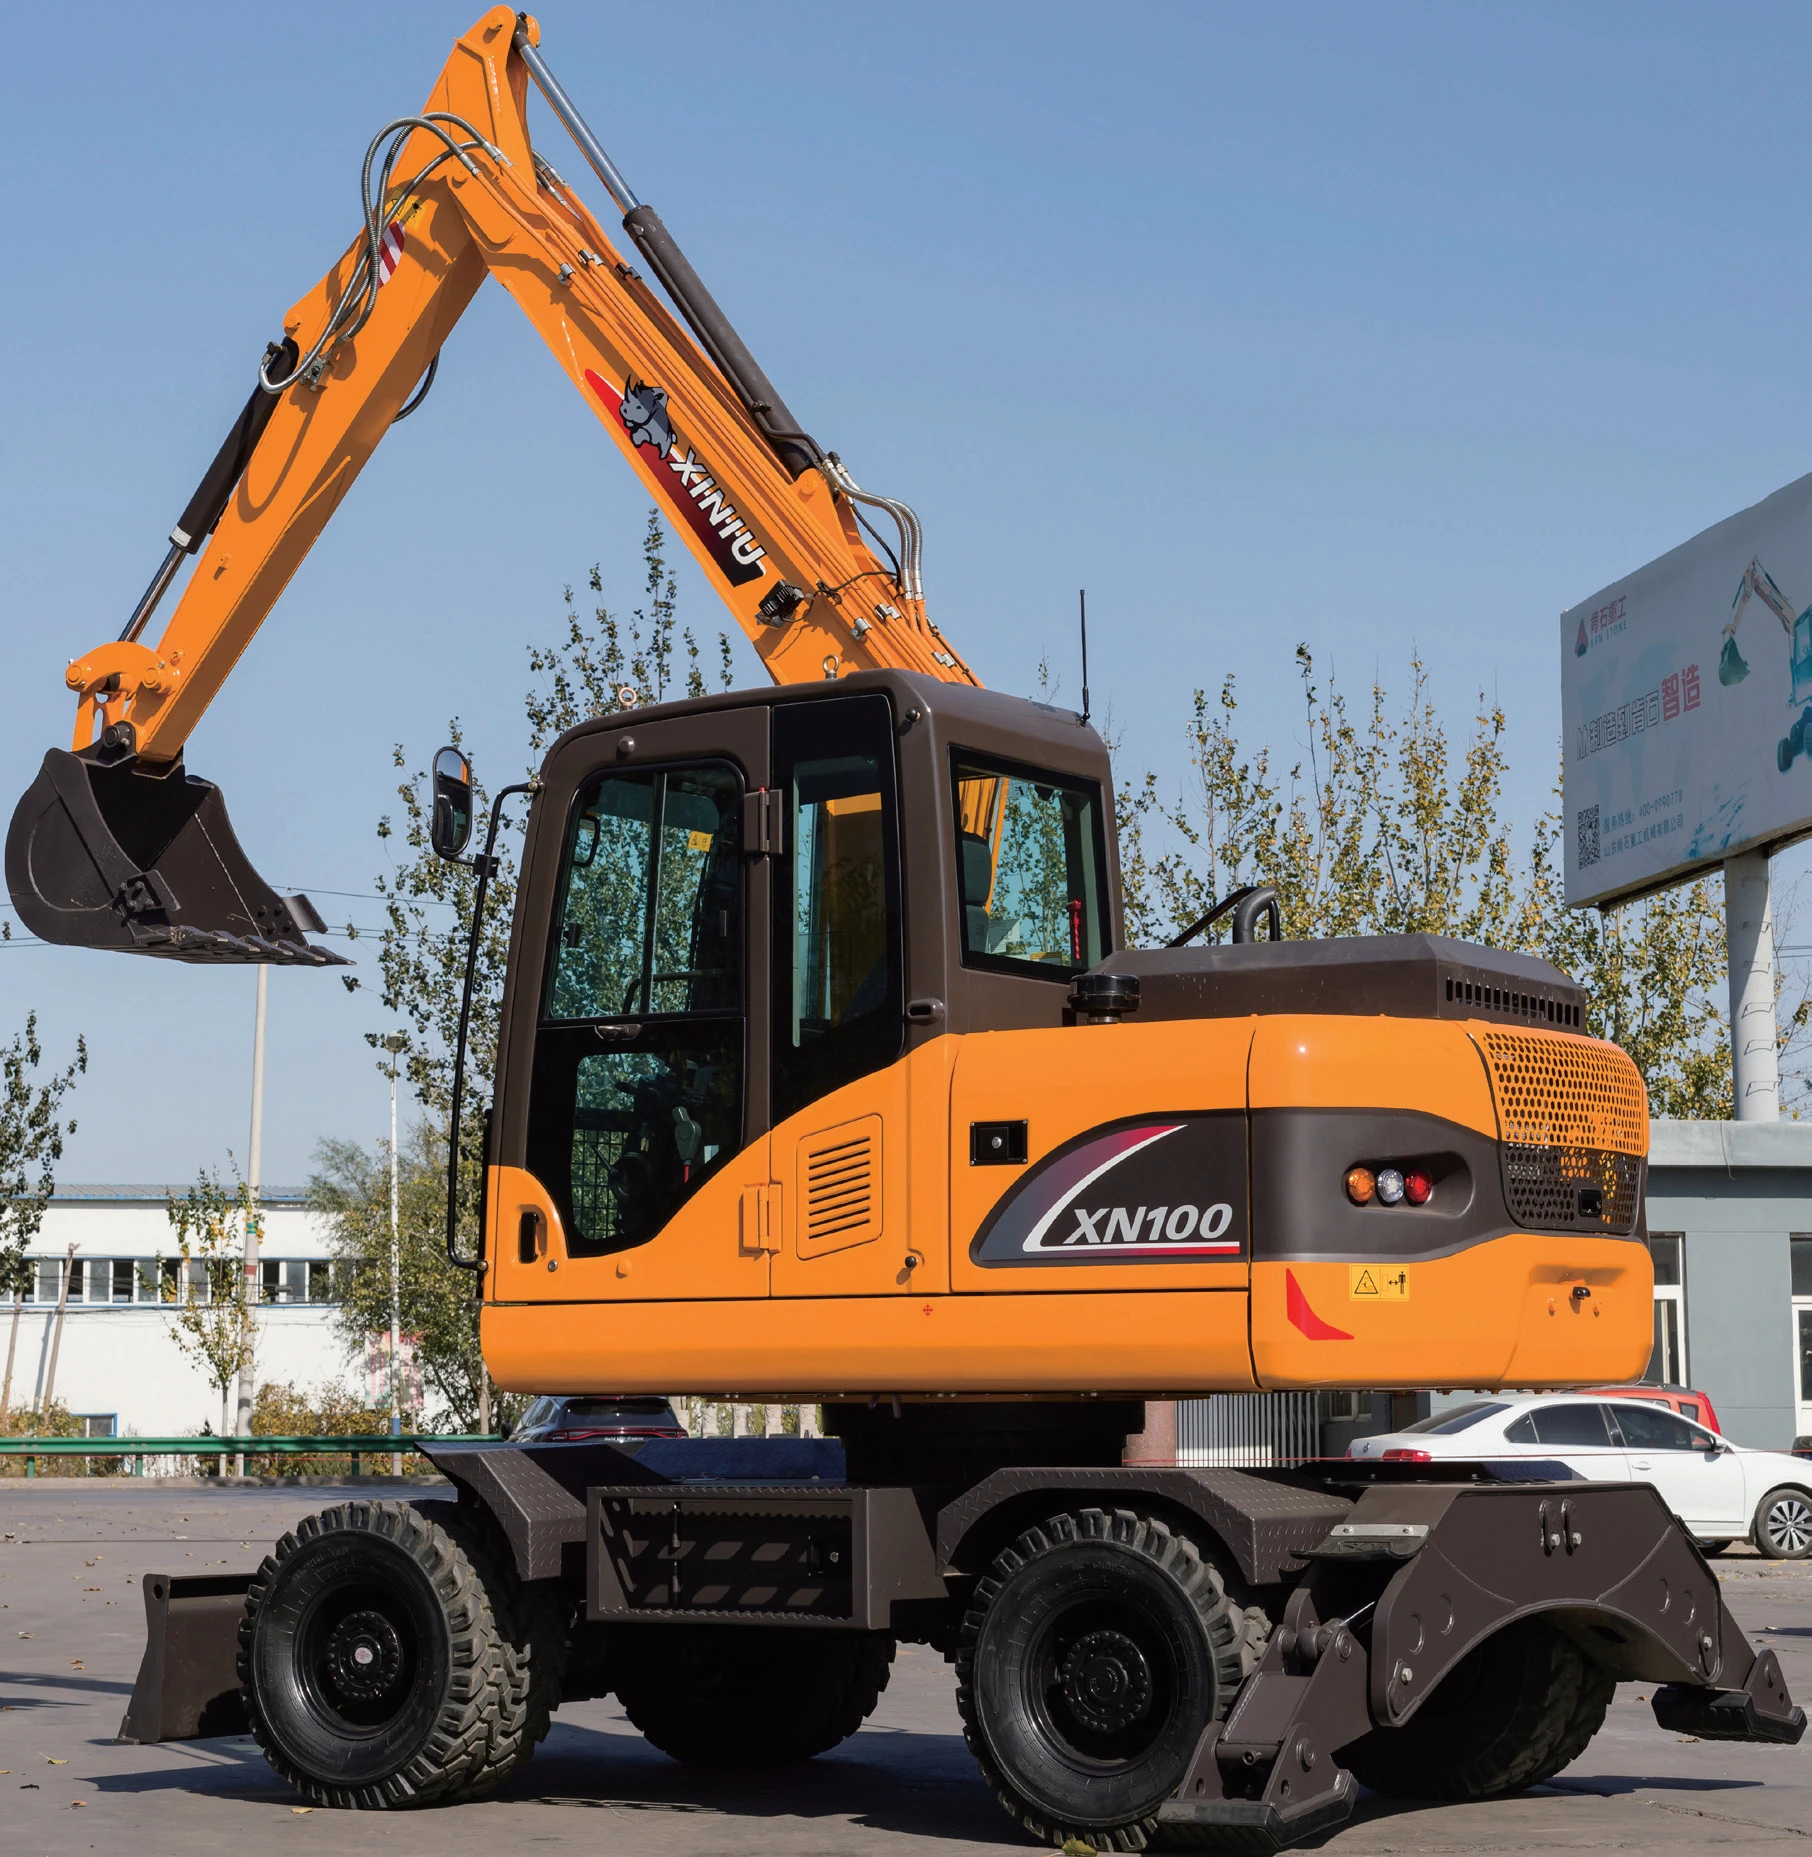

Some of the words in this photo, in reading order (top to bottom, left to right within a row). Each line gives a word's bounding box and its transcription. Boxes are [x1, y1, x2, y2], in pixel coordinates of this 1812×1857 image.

[668, 446, 767, 566] XINIU
[1590, 595, 1627, 635] 肯石重工
[1606, 619, 1627, 640] STONE
[1604, 813, 1684, 857] 山东肯石重工机械有限公司
[1063, 1203, 1233, 1244] XN100
